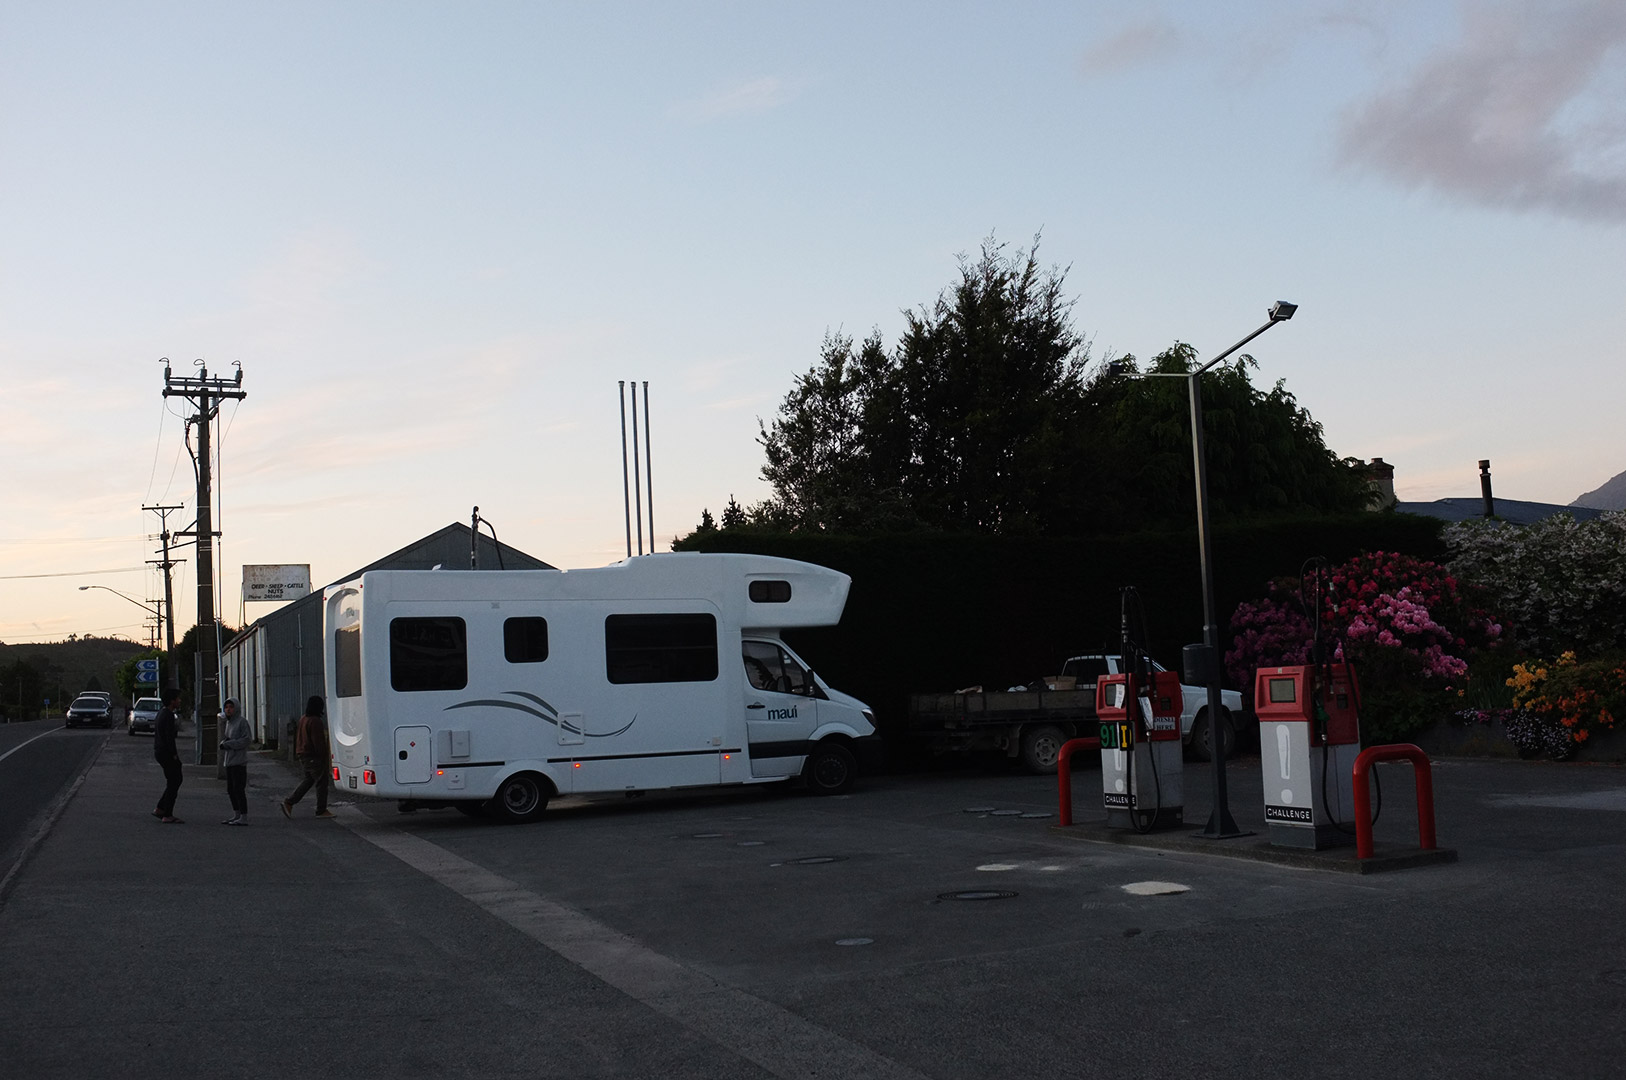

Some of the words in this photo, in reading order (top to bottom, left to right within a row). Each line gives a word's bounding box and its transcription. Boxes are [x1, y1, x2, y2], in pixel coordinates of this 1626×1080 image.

[768, 705, 798, 720] maui
[1100, 725, 1117, 748] 91
[1105, 795, 1135, 804] CHALLENE
[1267, 808, 1310, 819] CHALLENGE
